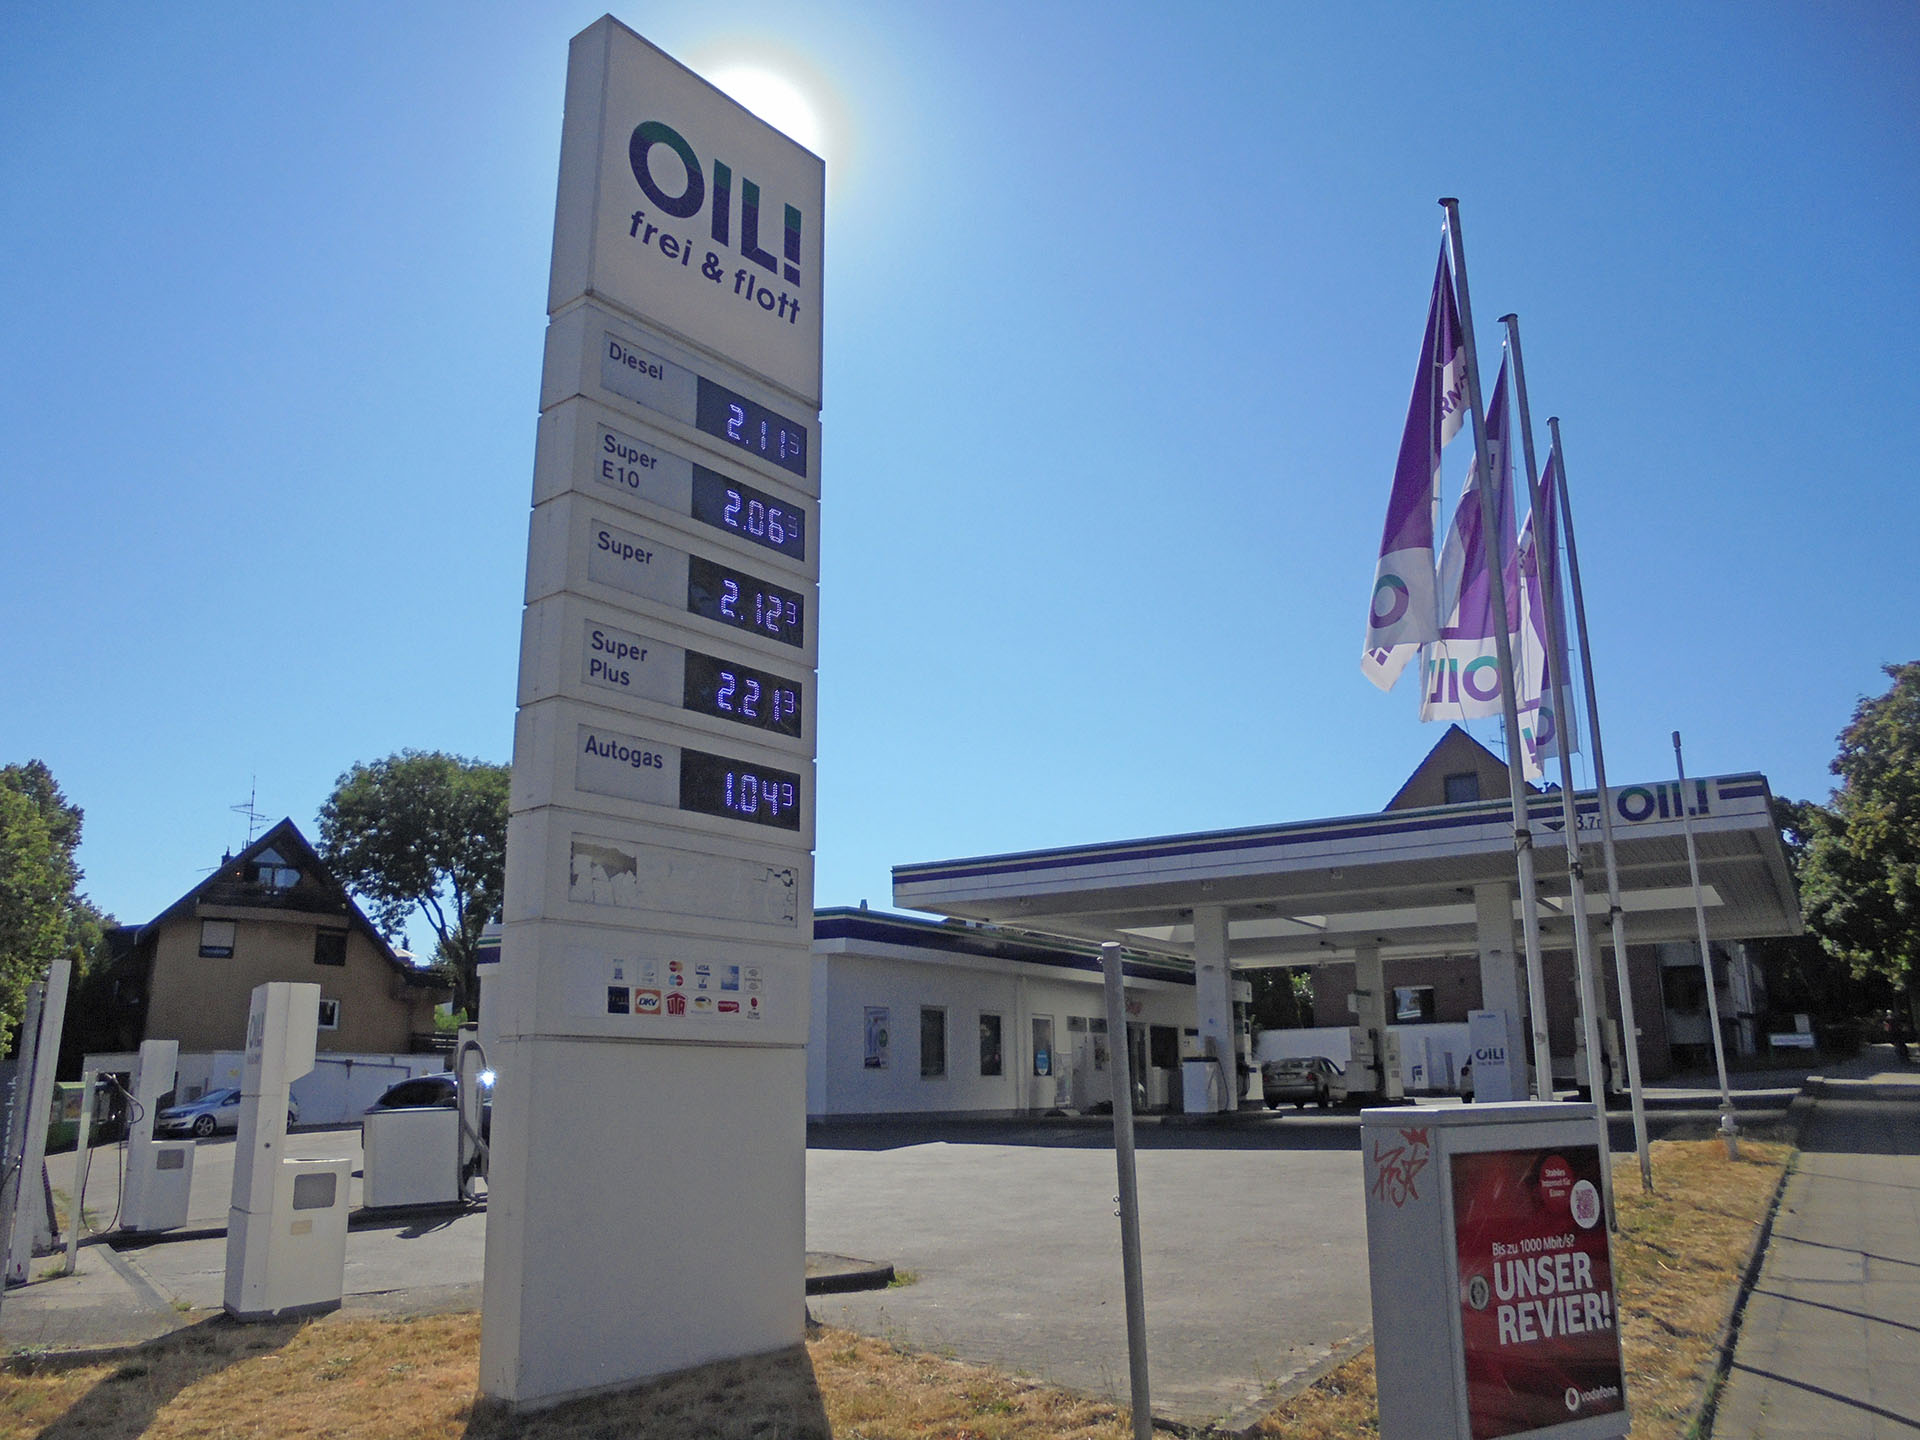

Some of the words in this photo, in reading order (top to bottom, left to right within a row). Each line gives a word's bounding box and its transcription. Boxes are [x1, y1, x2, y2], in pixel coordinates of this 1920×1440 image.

[629, 120, 801, 288] OIL!
[629, 210, 692, 266] frei
[701, 252, 724, 283] &
[734, 269, 800, 324] flott
[609, 341, 663, 381] Diesel
[603, 434, 657, 470] Super
[602, 460, 640, 489] E10
[597, 530, 653, 565] Super
[591, 630, 648, 662] Super
[589, 658, 631, 686] Plus
[584, 734, 664, 770] Autogas
[638, 997, 658, 1007] DKV
[1492, 1241, 1505, 1257] Bis
[1507, 1243, 1519, 1255] zu
[1520, 1237, 1542, 1253] 1000
[1494, 1251, 1593, 1301] UNSER
[1497, 1290, 1611, 1345] REVIER!
